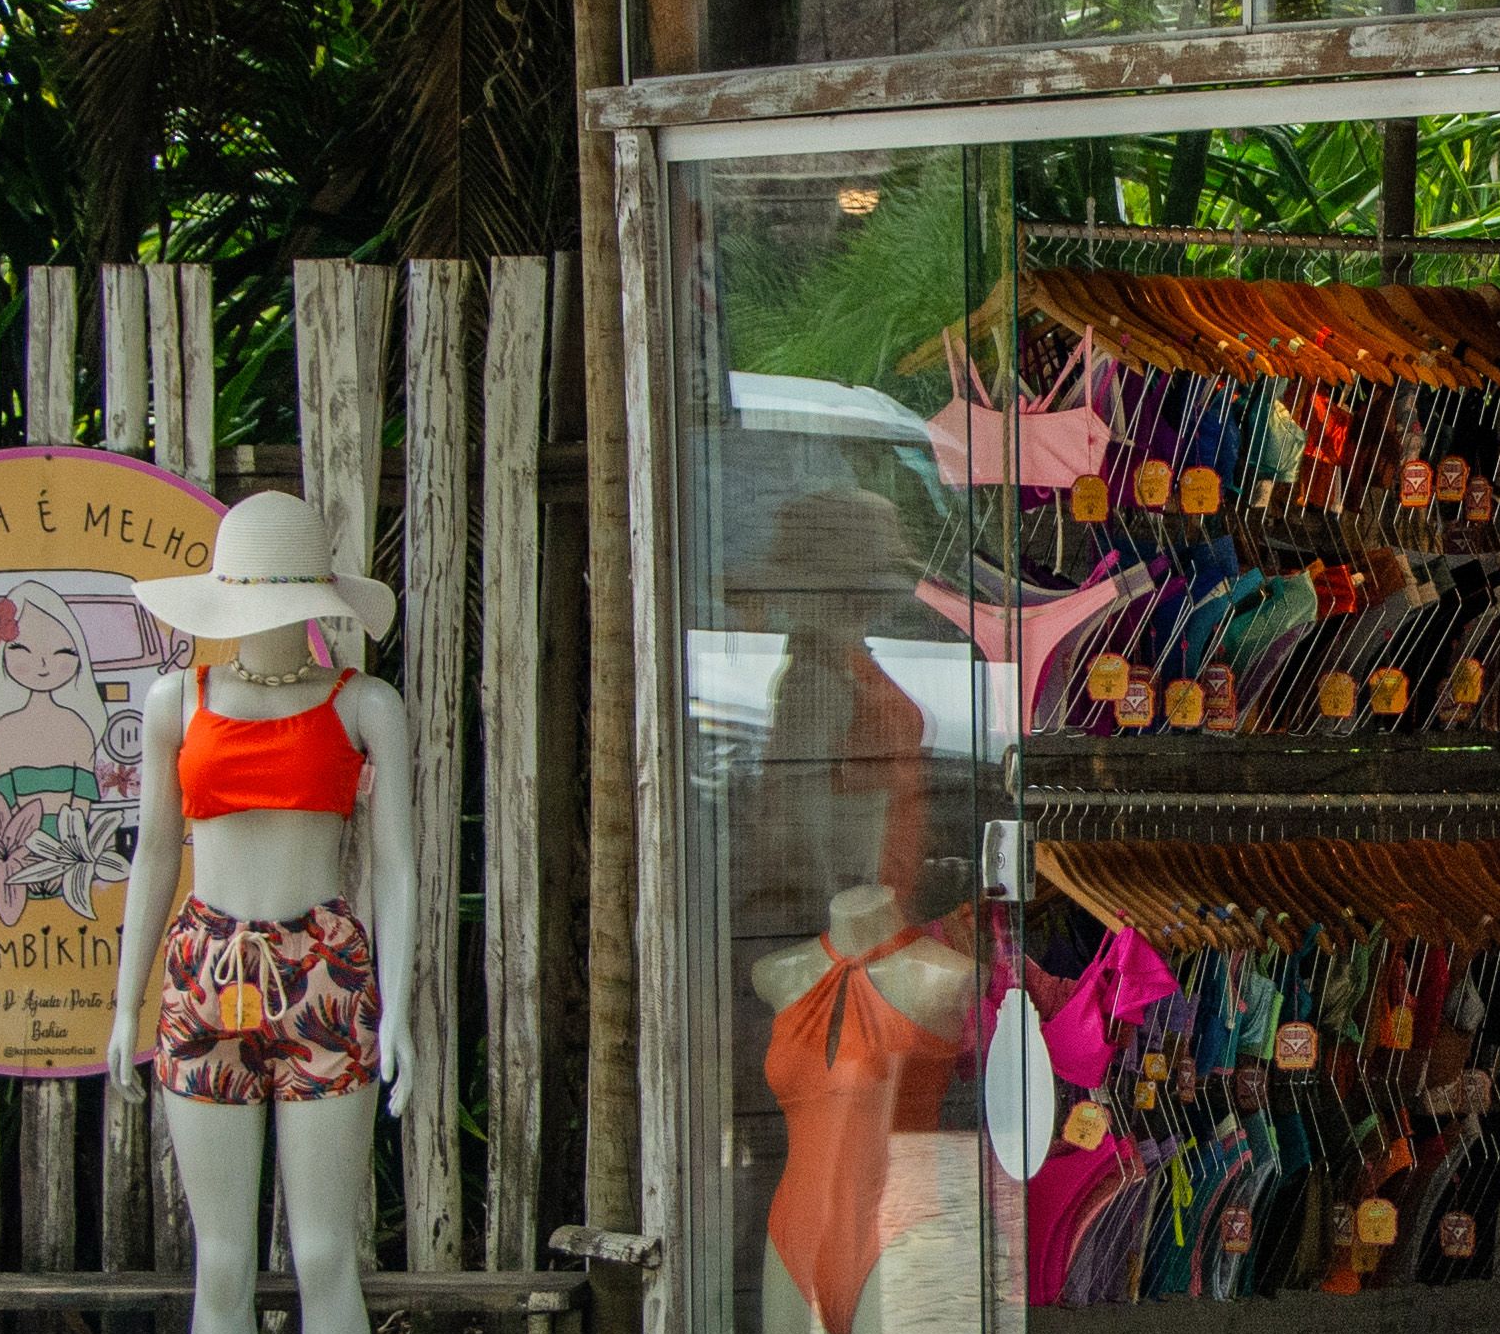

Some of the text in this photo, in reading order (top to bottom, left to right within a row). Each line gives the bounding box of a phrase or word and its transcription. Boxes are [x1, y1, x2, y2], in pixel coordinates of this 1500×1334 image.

[37, 489, 57, 533] É
[84, 502, 209, 568] MELHO
[22, 988, 61, 1017] Ajuda
[70, 989, 103, 1011] Porto
[31, 1019, 68, 1041] Bahia
